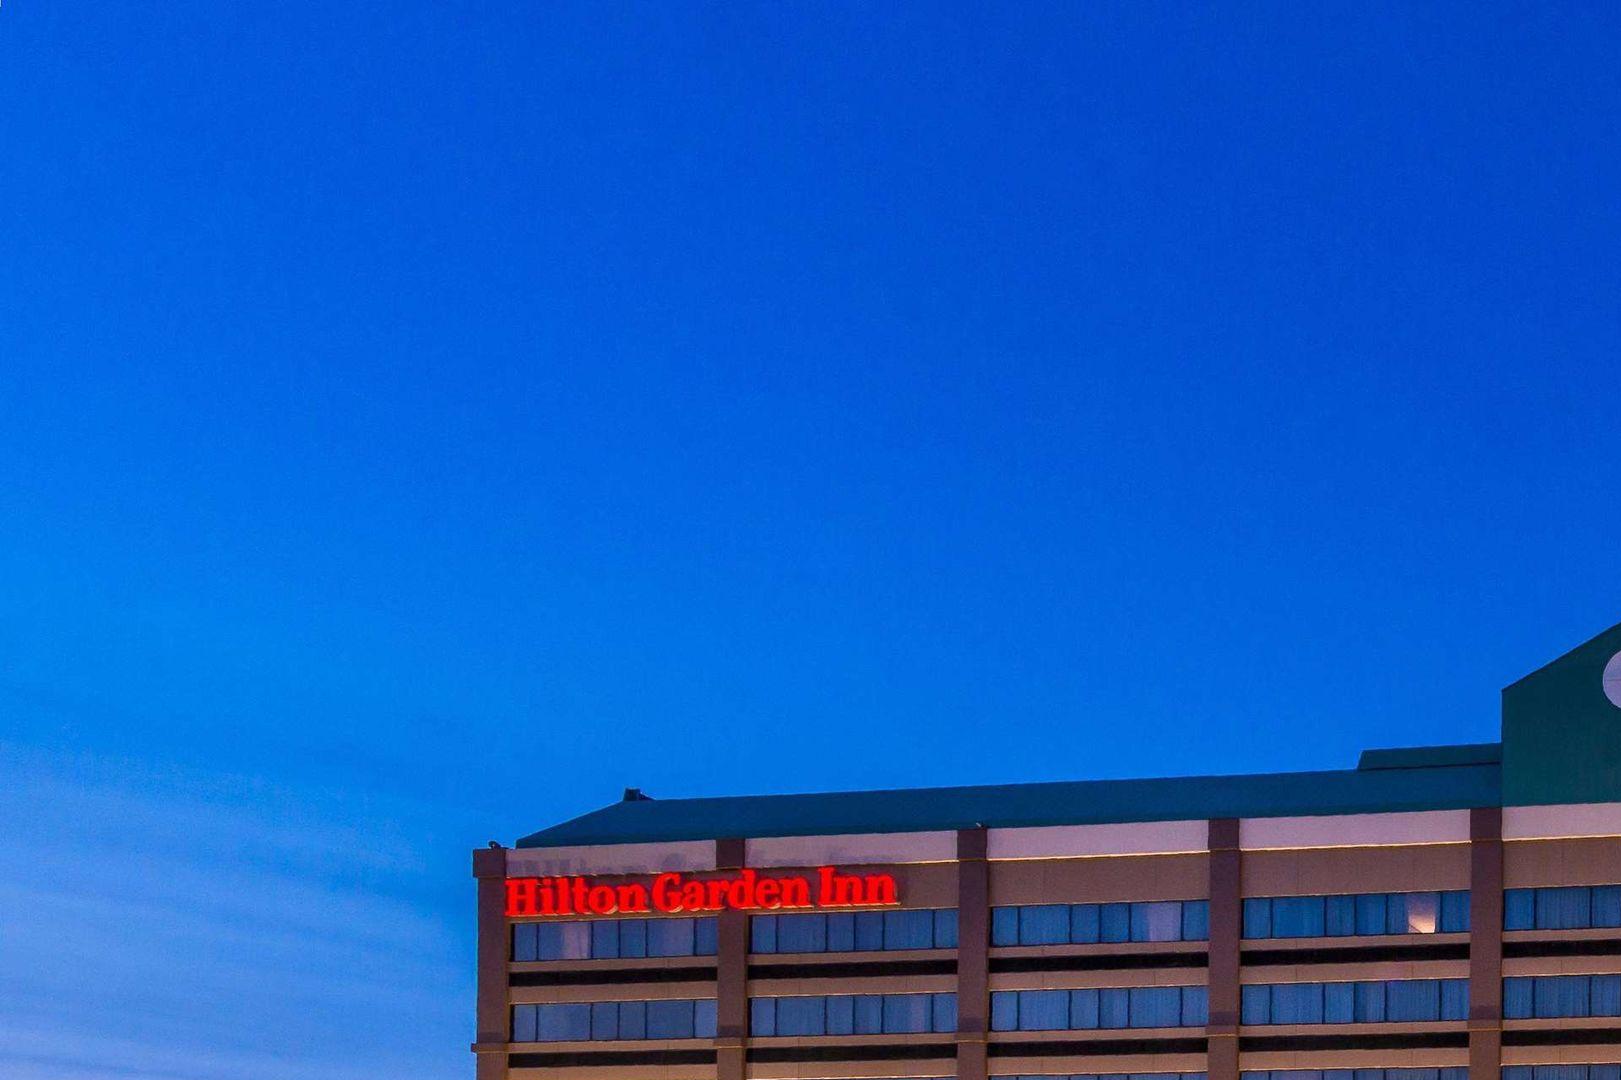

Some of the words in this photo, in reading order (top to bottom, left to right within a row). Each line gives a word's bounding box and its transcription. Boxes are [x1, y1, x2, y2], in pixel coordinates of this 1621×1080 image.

[505, 876, 650, 916] Hilton
[652, 867, 813, 913] Garden
[818, 865, 899, 908] Inn
